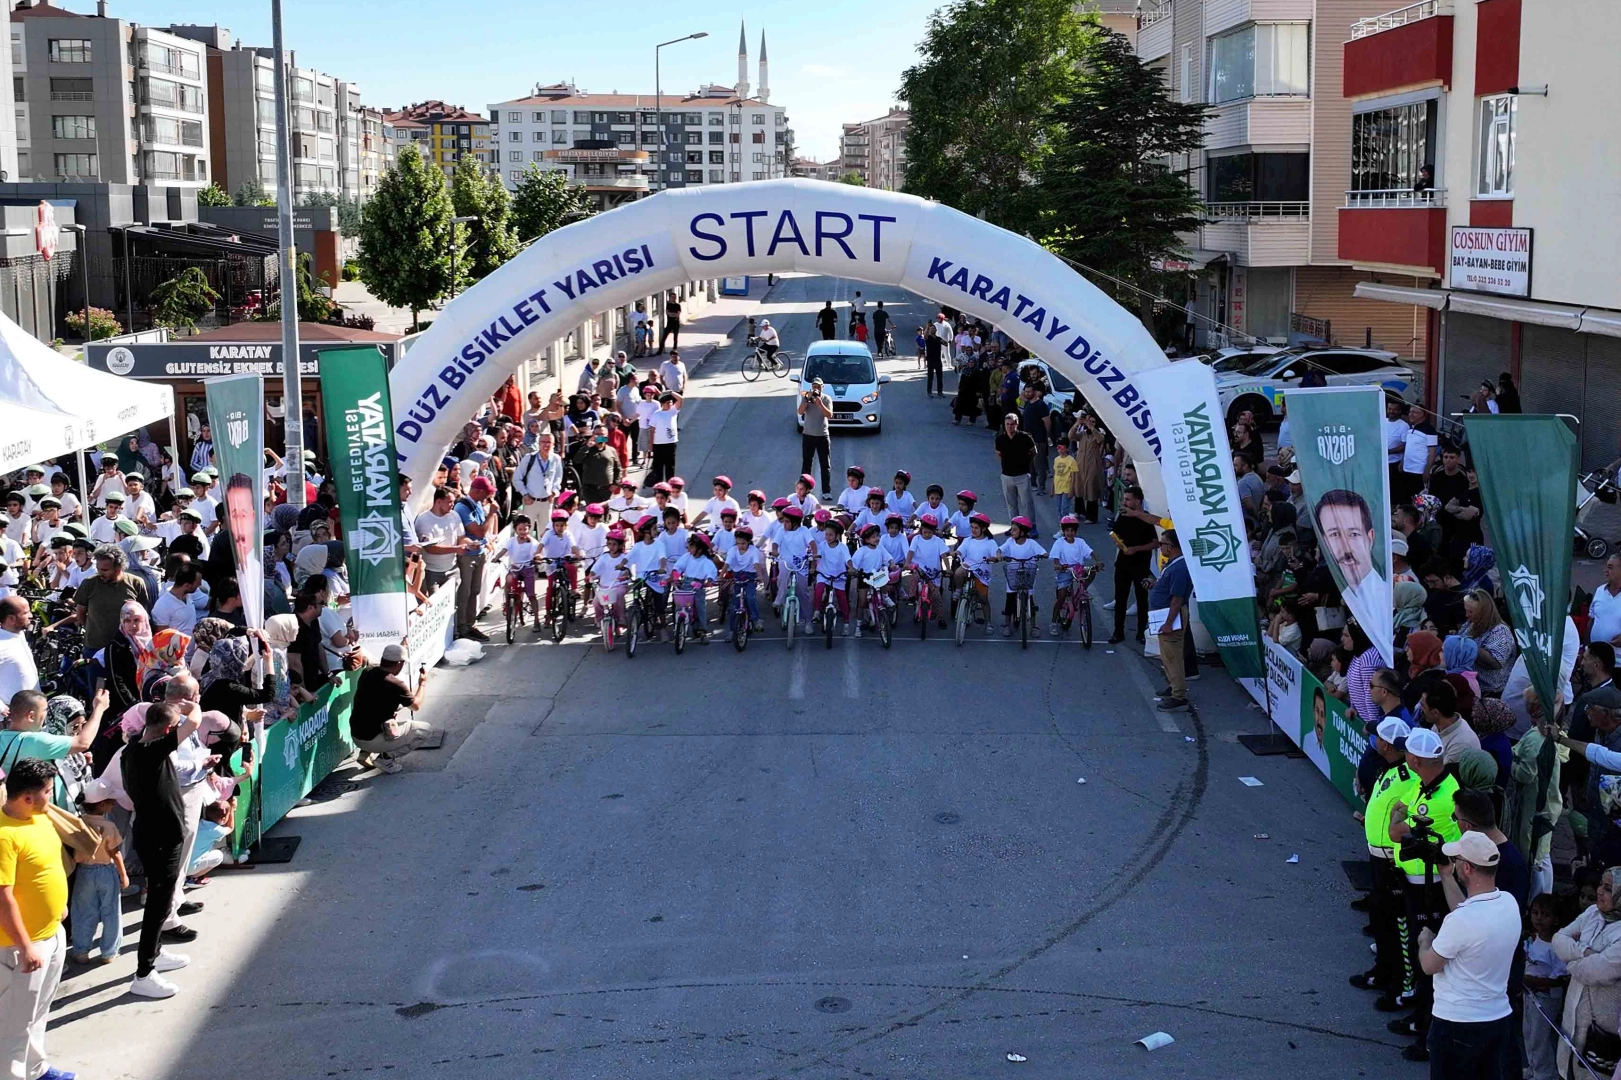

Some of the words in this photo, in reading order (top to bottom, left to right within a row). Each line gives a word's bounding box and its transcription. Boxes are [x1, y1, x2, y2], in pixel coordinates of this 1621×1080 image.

[689, 209, 897, 263] START
[1454, 231, 1494, 254] COŞKUN
[1496, 230, 1528, 253] GİYİM
[1453, 256, 1505, 271] BAY-BAYAN-BEBE
[1506, 258, 1527, 273] GİYİM
[395, 383, 452, 444] DÜZ
[438, 289, 552, 391] BİSİKLET
[553, 244, 654, 300] YARIŞI
[927, 256, 1071, 342] KARATAY
[1064, 334, 1127, 392] DÜZ
[165, 360, 232, 374] GLUTENSİZ
[233, 361, 274, 374] EKMEK
[276, 359, 319, 374] BESİ
[209, 346, 273, 359] KARATAY
[299, 704, 330, 746] KARATAY
[1331, 710, 1346, 737] TÜM
[1347, 724, 1369, 754] YARIŞ
